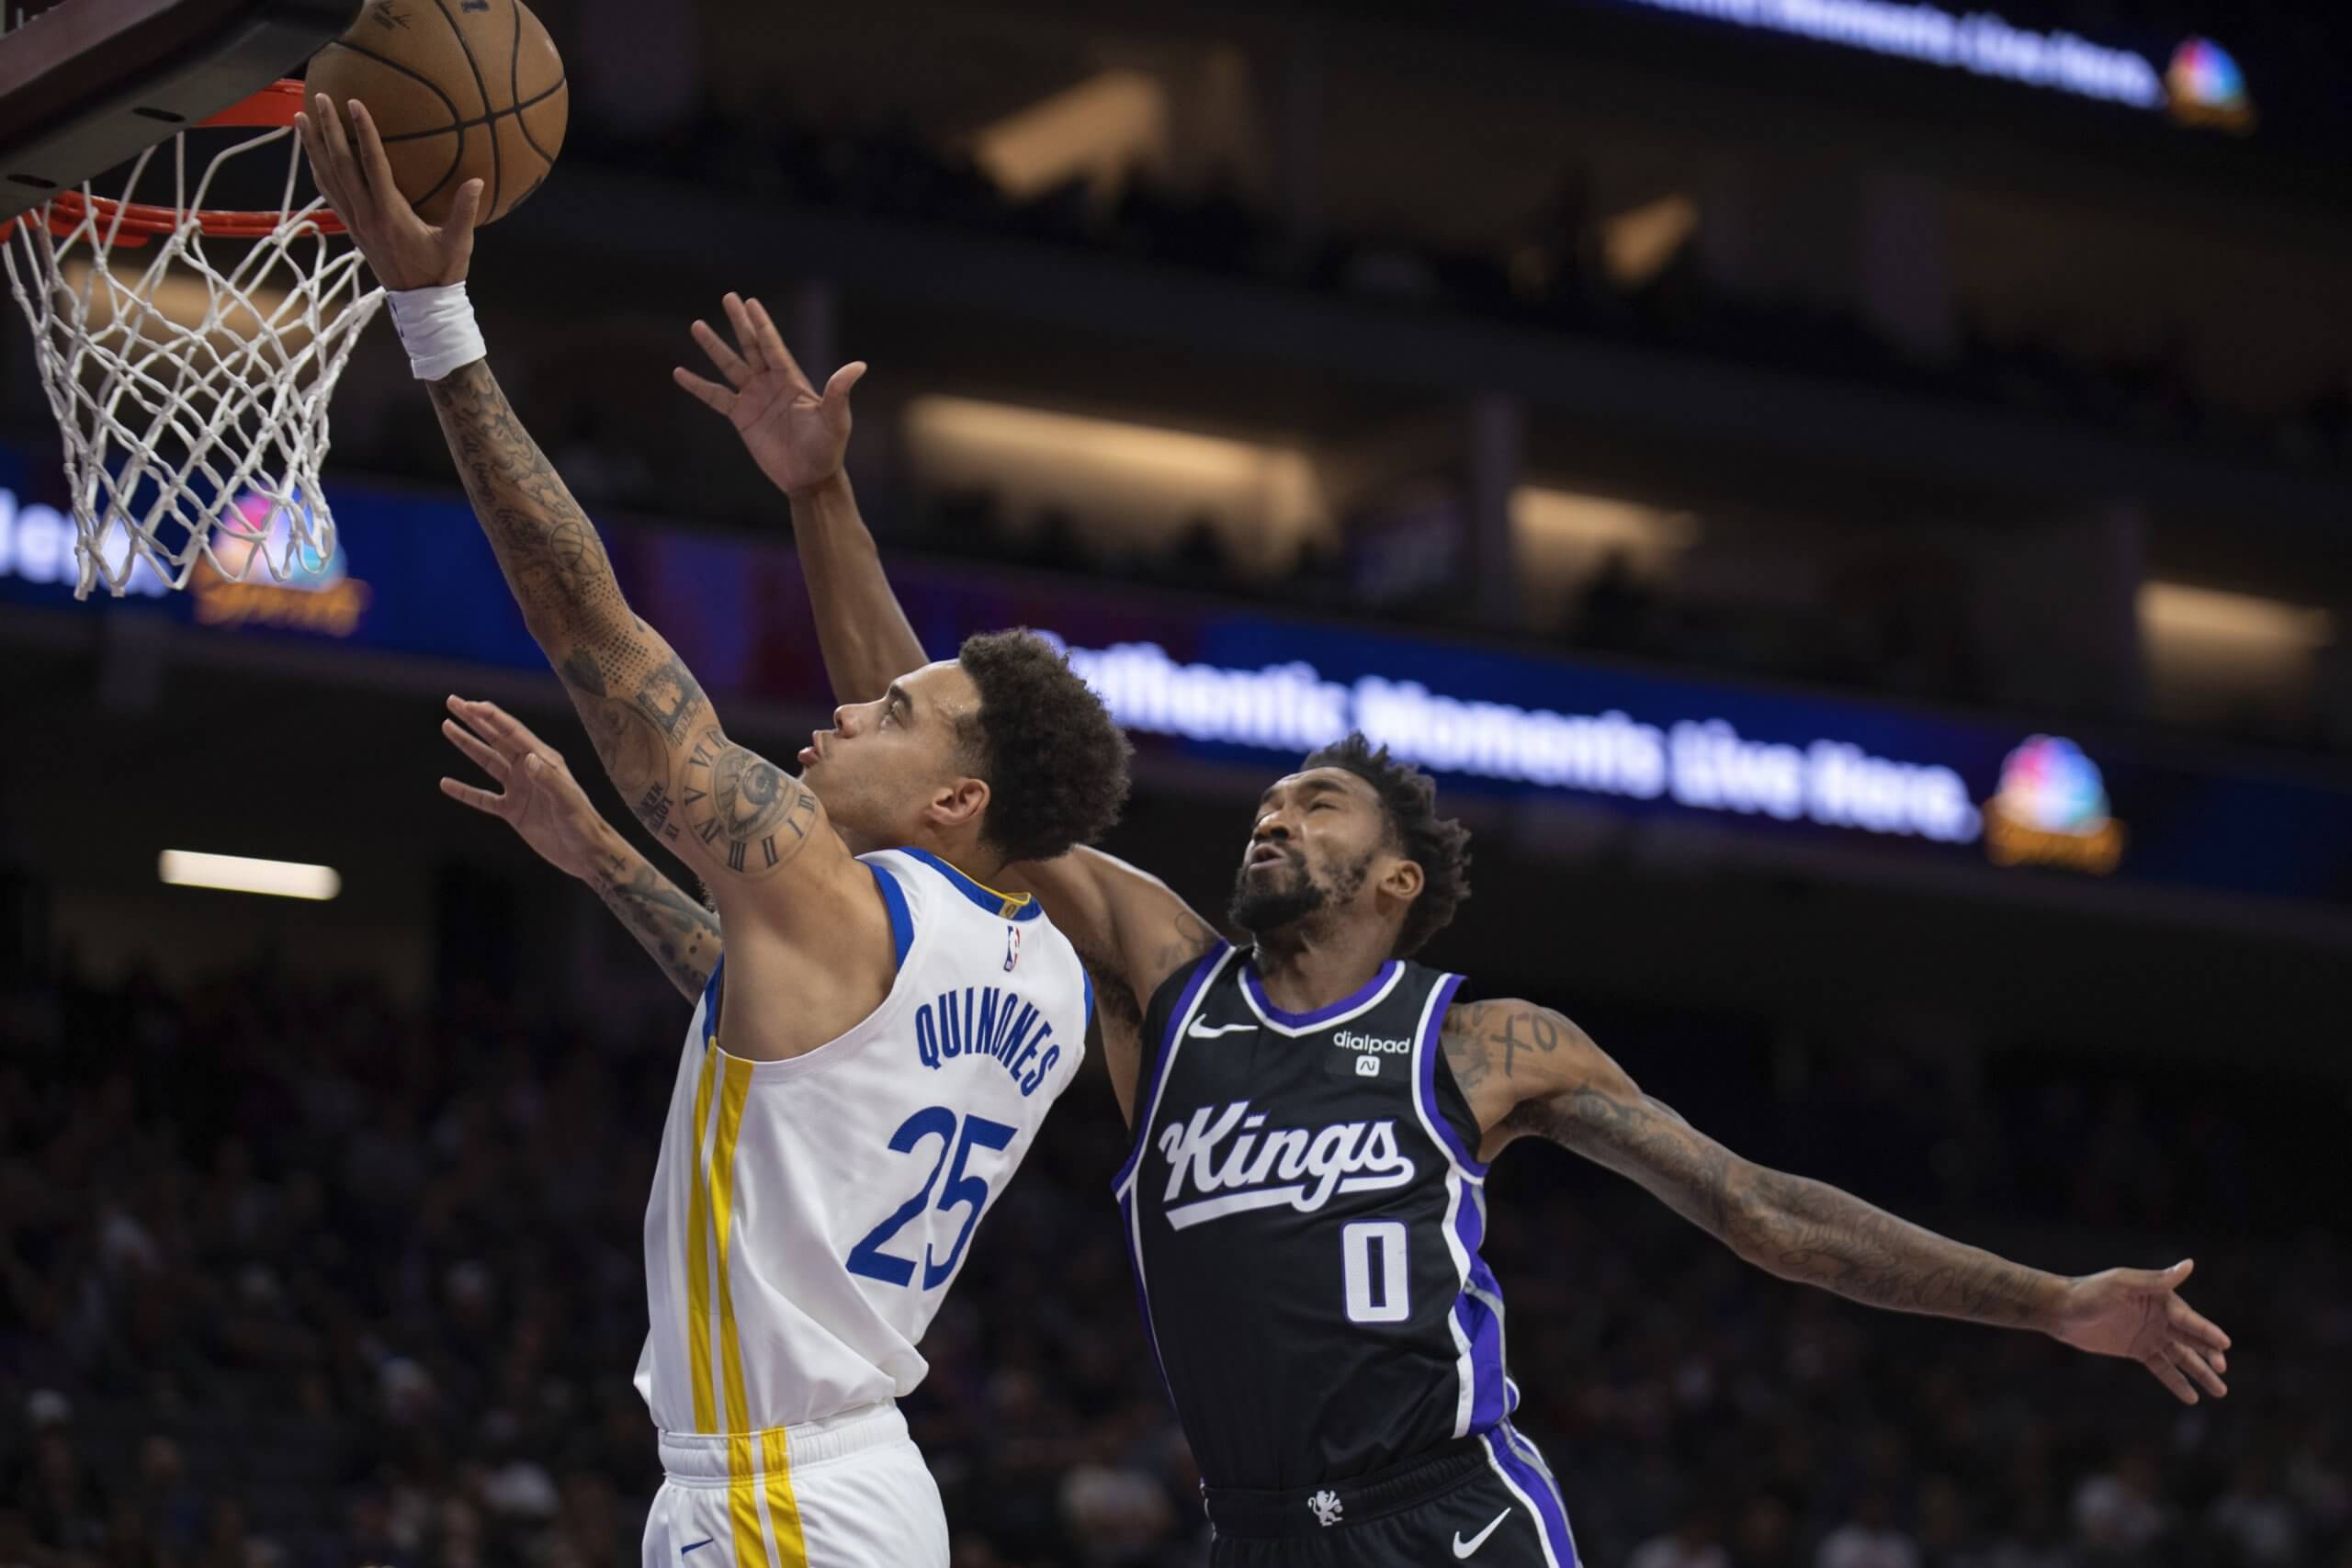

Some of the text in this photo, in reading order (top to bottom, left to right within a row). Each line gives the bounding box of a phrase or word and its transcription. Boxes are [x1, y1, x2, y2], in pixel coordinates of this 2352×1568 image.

[914, 986, 1061, 1098] QUINONES
[1332, 1030, 1411, 1055] dialpad
[845, 1105, 1019, 1292] 25
[1157, 1100, 1416, 1218] Kings
[1340, 1219, 1412, 1324] 0
